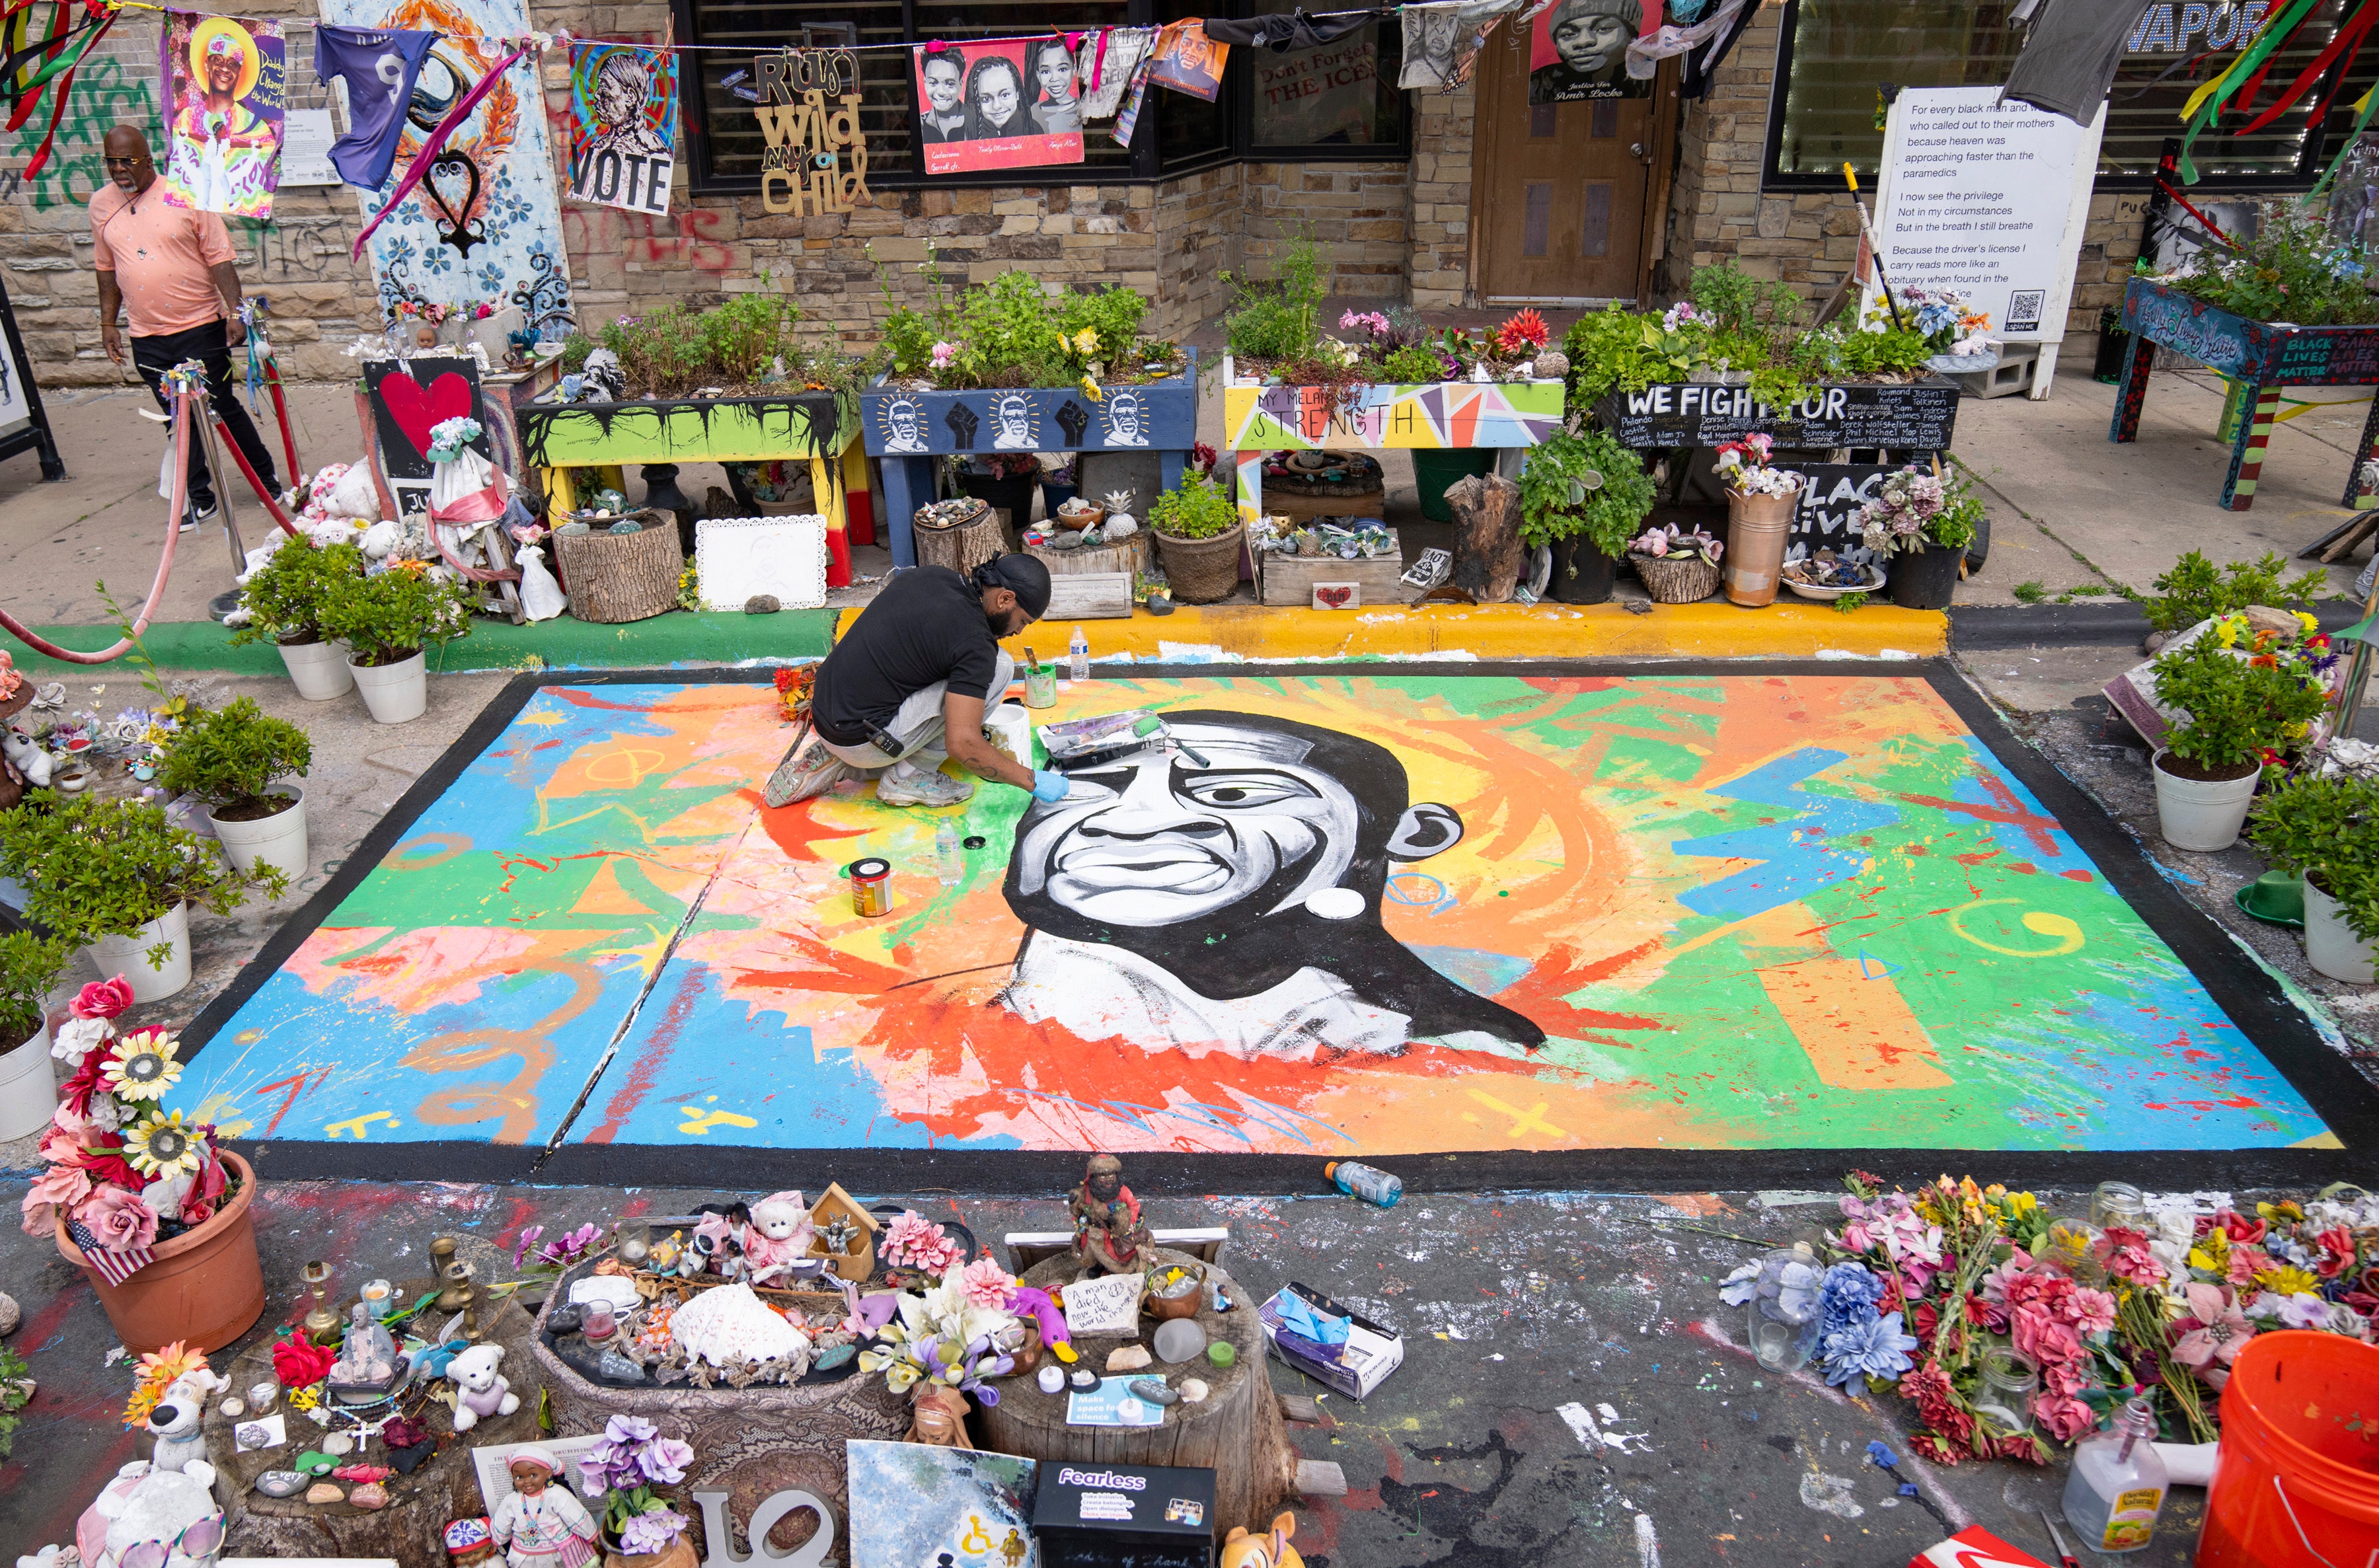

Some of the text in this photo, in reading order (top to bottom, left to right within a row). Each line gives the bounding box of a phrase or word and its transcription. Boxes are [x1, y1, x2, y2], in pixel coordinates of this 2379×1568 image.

[259, 49, 285, 78] Daddy
[1260, 42, 1370, 84] Don't Forget
[1265, 61, 1377, 105] THE ICE!
[1568, 81, 1595, 91] Justice
[251, 91, 260, 104] the
[1555, 88, 1623, 100] Amir Locke
[1912, 105, 1928, 114] For
[1930, 106, 1955, 116] every
[1958, 104, 1983, 113] black
[2010, 104, 2027, 112] and
[1910, 122, 1930, 130] who
[1932, 120, 1959, 130] called
[1993, 120, 2014, 129] their
[2016, 119, 2055, 128] mothers
[1908, 137, 1947, 147] because
[1949, 137, 1983, 146] heaven
[1905, 151, 2034, 163] approaching faster than the
[571, 145, 671, 212] VOTE
[1903, 168, 1957, 180] paramedics
[1900, 192, 1903, 201] I
[1963, 192, 2004, 202] privilege
[1898, 207, 2012, 217] Not in my circumstances
[1896, 223, 1912, 232] But
[1926, 223, 1940, 231] the
[1942, 222, 1971, 231] breath
[1980, 221, 1996, 230] still
[1998, 221, 2033, 230] breathe
[1893, 246, 1932, 254] Because
[1935, 245, 1949, 254] the
[1951, 244, 1985, 253] driver's
[1988, 244, 2020, 252] license
[1890, 261, 1913, 271] carry
[1916, 260, 1941, 268] reads
[1969, 260, 1985, 268] like
[1888, 276, 1924, 285] obituary
[1928, 275, 1951, 283] when
[1953, 274, 1981, 283] found
[1994, 274, 2008, 283] the
[2286, 335, 2379, 350] BLACK GANG
[2283, 352, 2329, 363] LIVES
[1258, 394, 1277, 407] MY
[1628, 386, 1672, 415] WE
[1254, 404, 1412, 438] STRENGTH
[1621, 416, 1653, 428] Philando
[1755, 417, 1781, 426] George
[1620, 426, 1647, 437] Castile
[1903, 429, 1916, 437] Map
[1901, 437, 1917, 448] Kong
[1327, 593, 1345, 603] BLM
[1085, 1284, 1106, 1295] man
[1072, 1304, 1110, 1322] now the
[1079, 1314, 1106, 1328] world
[266, 1471, 304, 1483] Every
[1060, 1469, 1145, 1489] Fearless
